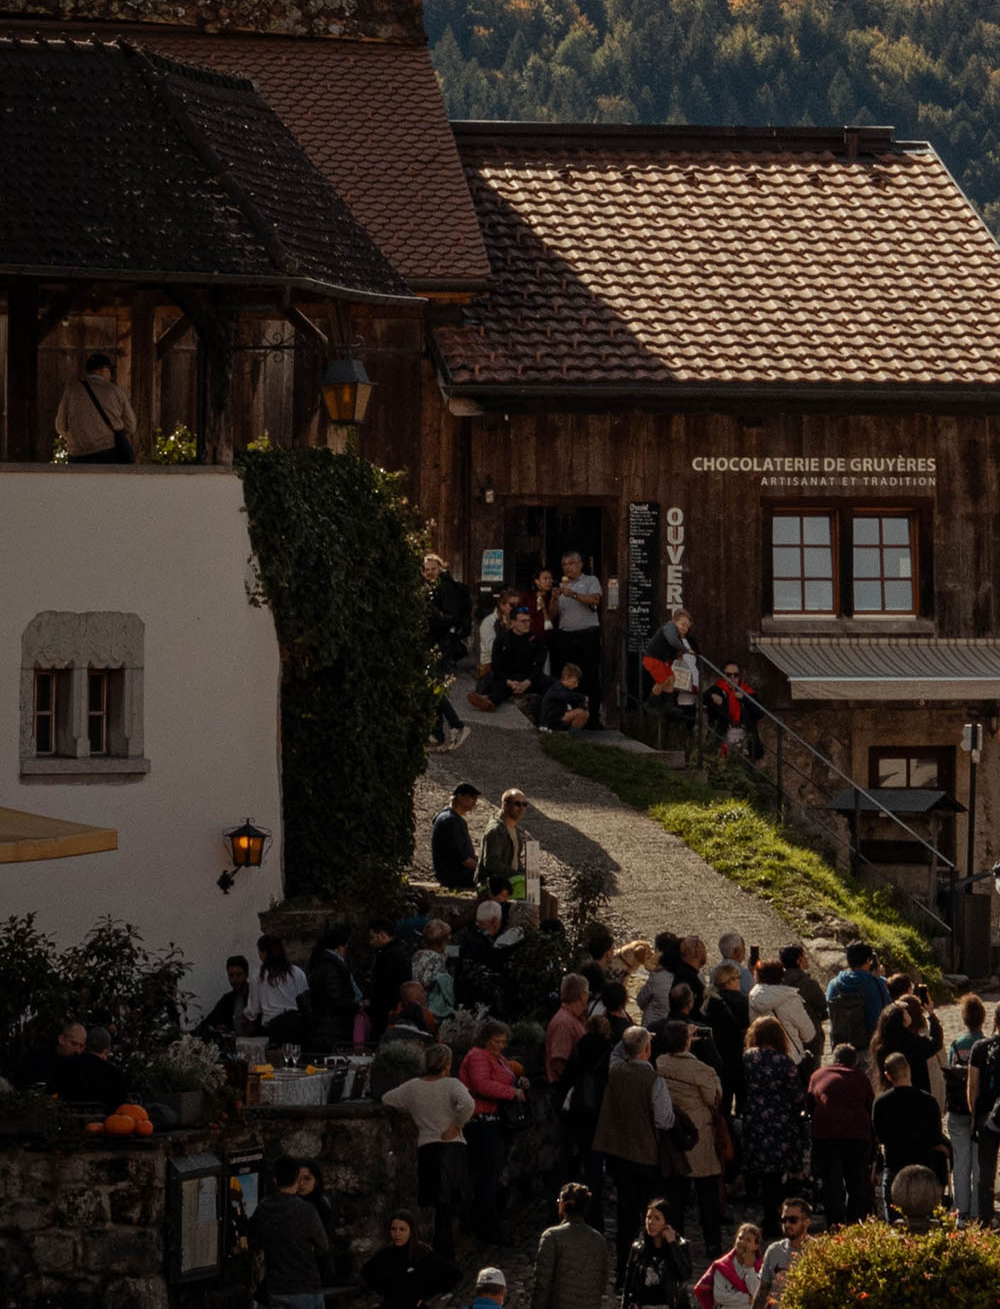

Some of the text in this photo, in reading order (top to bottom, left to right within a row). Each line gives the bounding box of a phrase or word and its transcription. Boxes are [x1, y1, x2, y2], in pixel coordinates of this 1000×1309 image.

[692, 455, 937, 472] CHOCOLATERIE DE GRUYÈRES
[761, 476, 937, 487] ARTISANAT ET TRADITION
[666, 507, 685, 620] OUVERT
